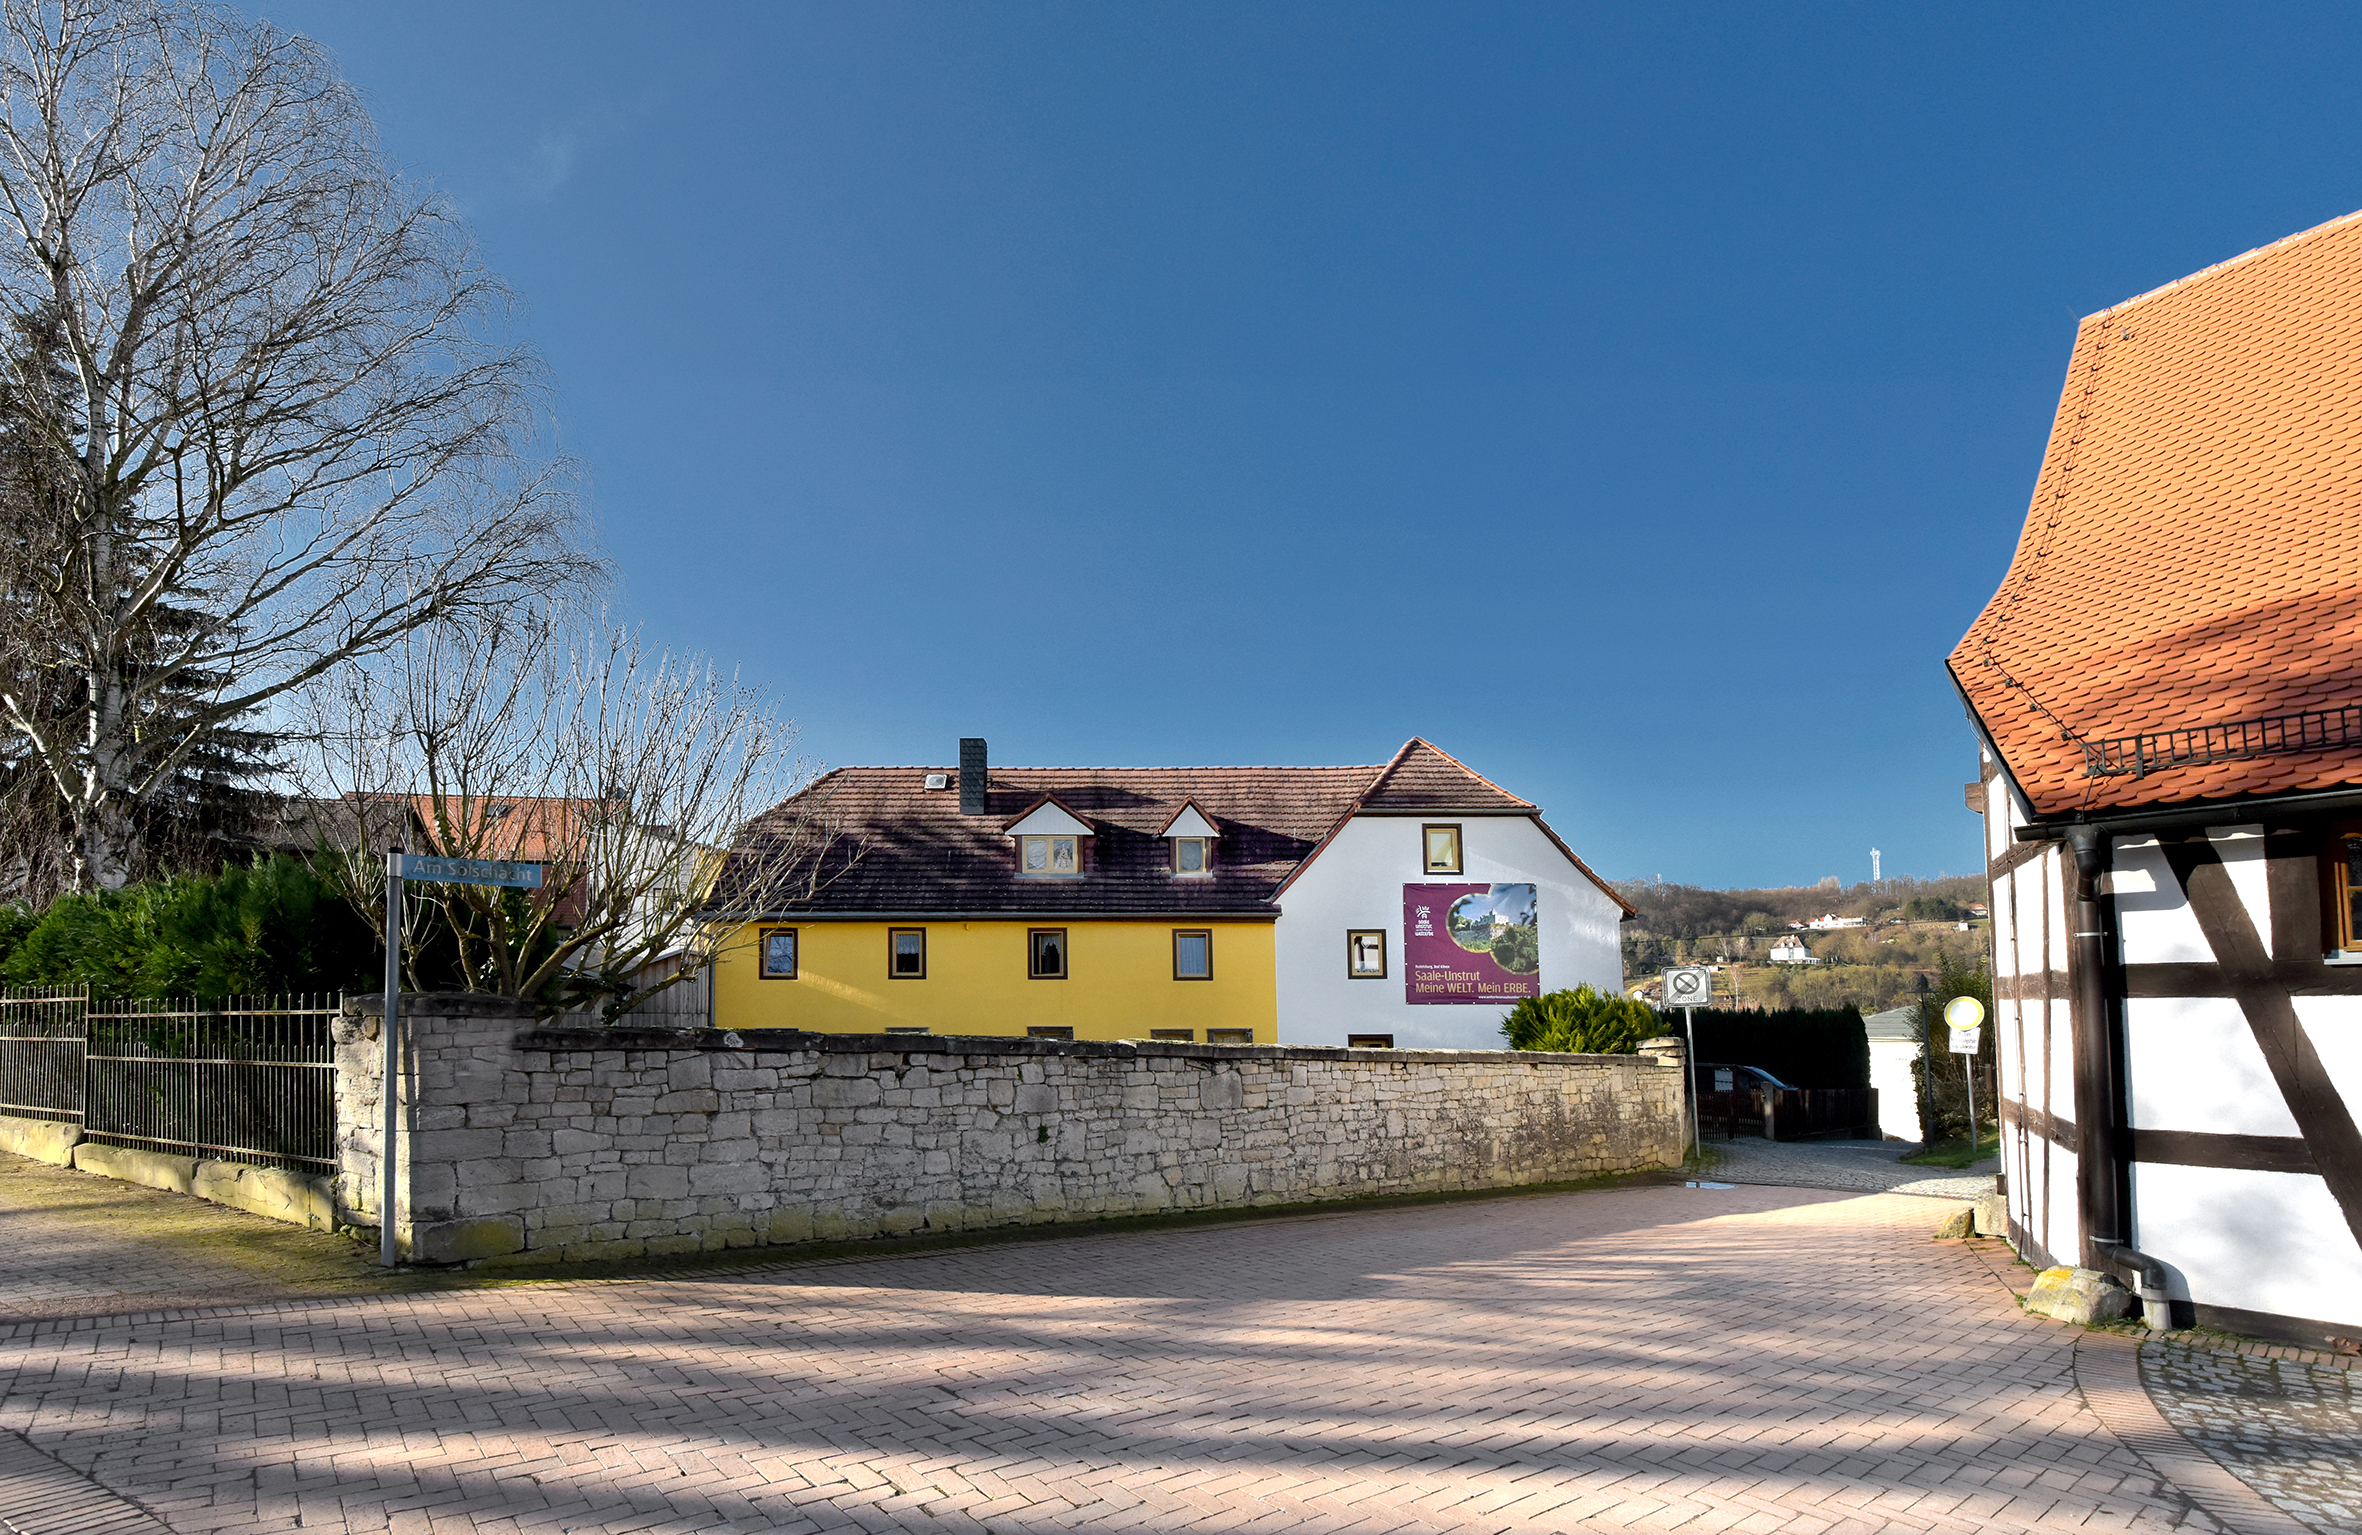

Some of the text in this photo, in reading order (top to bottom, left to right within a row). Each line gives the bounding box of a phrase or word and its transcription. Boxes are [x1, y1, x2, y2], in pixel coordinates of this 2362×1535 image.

[413, 860, 533, 882] Am Solschacht
[1415, 970, 1481, 981] Saale-Unstrut
[1416, 982, 1531, 993] Meine WELT. Mein ERBE.
